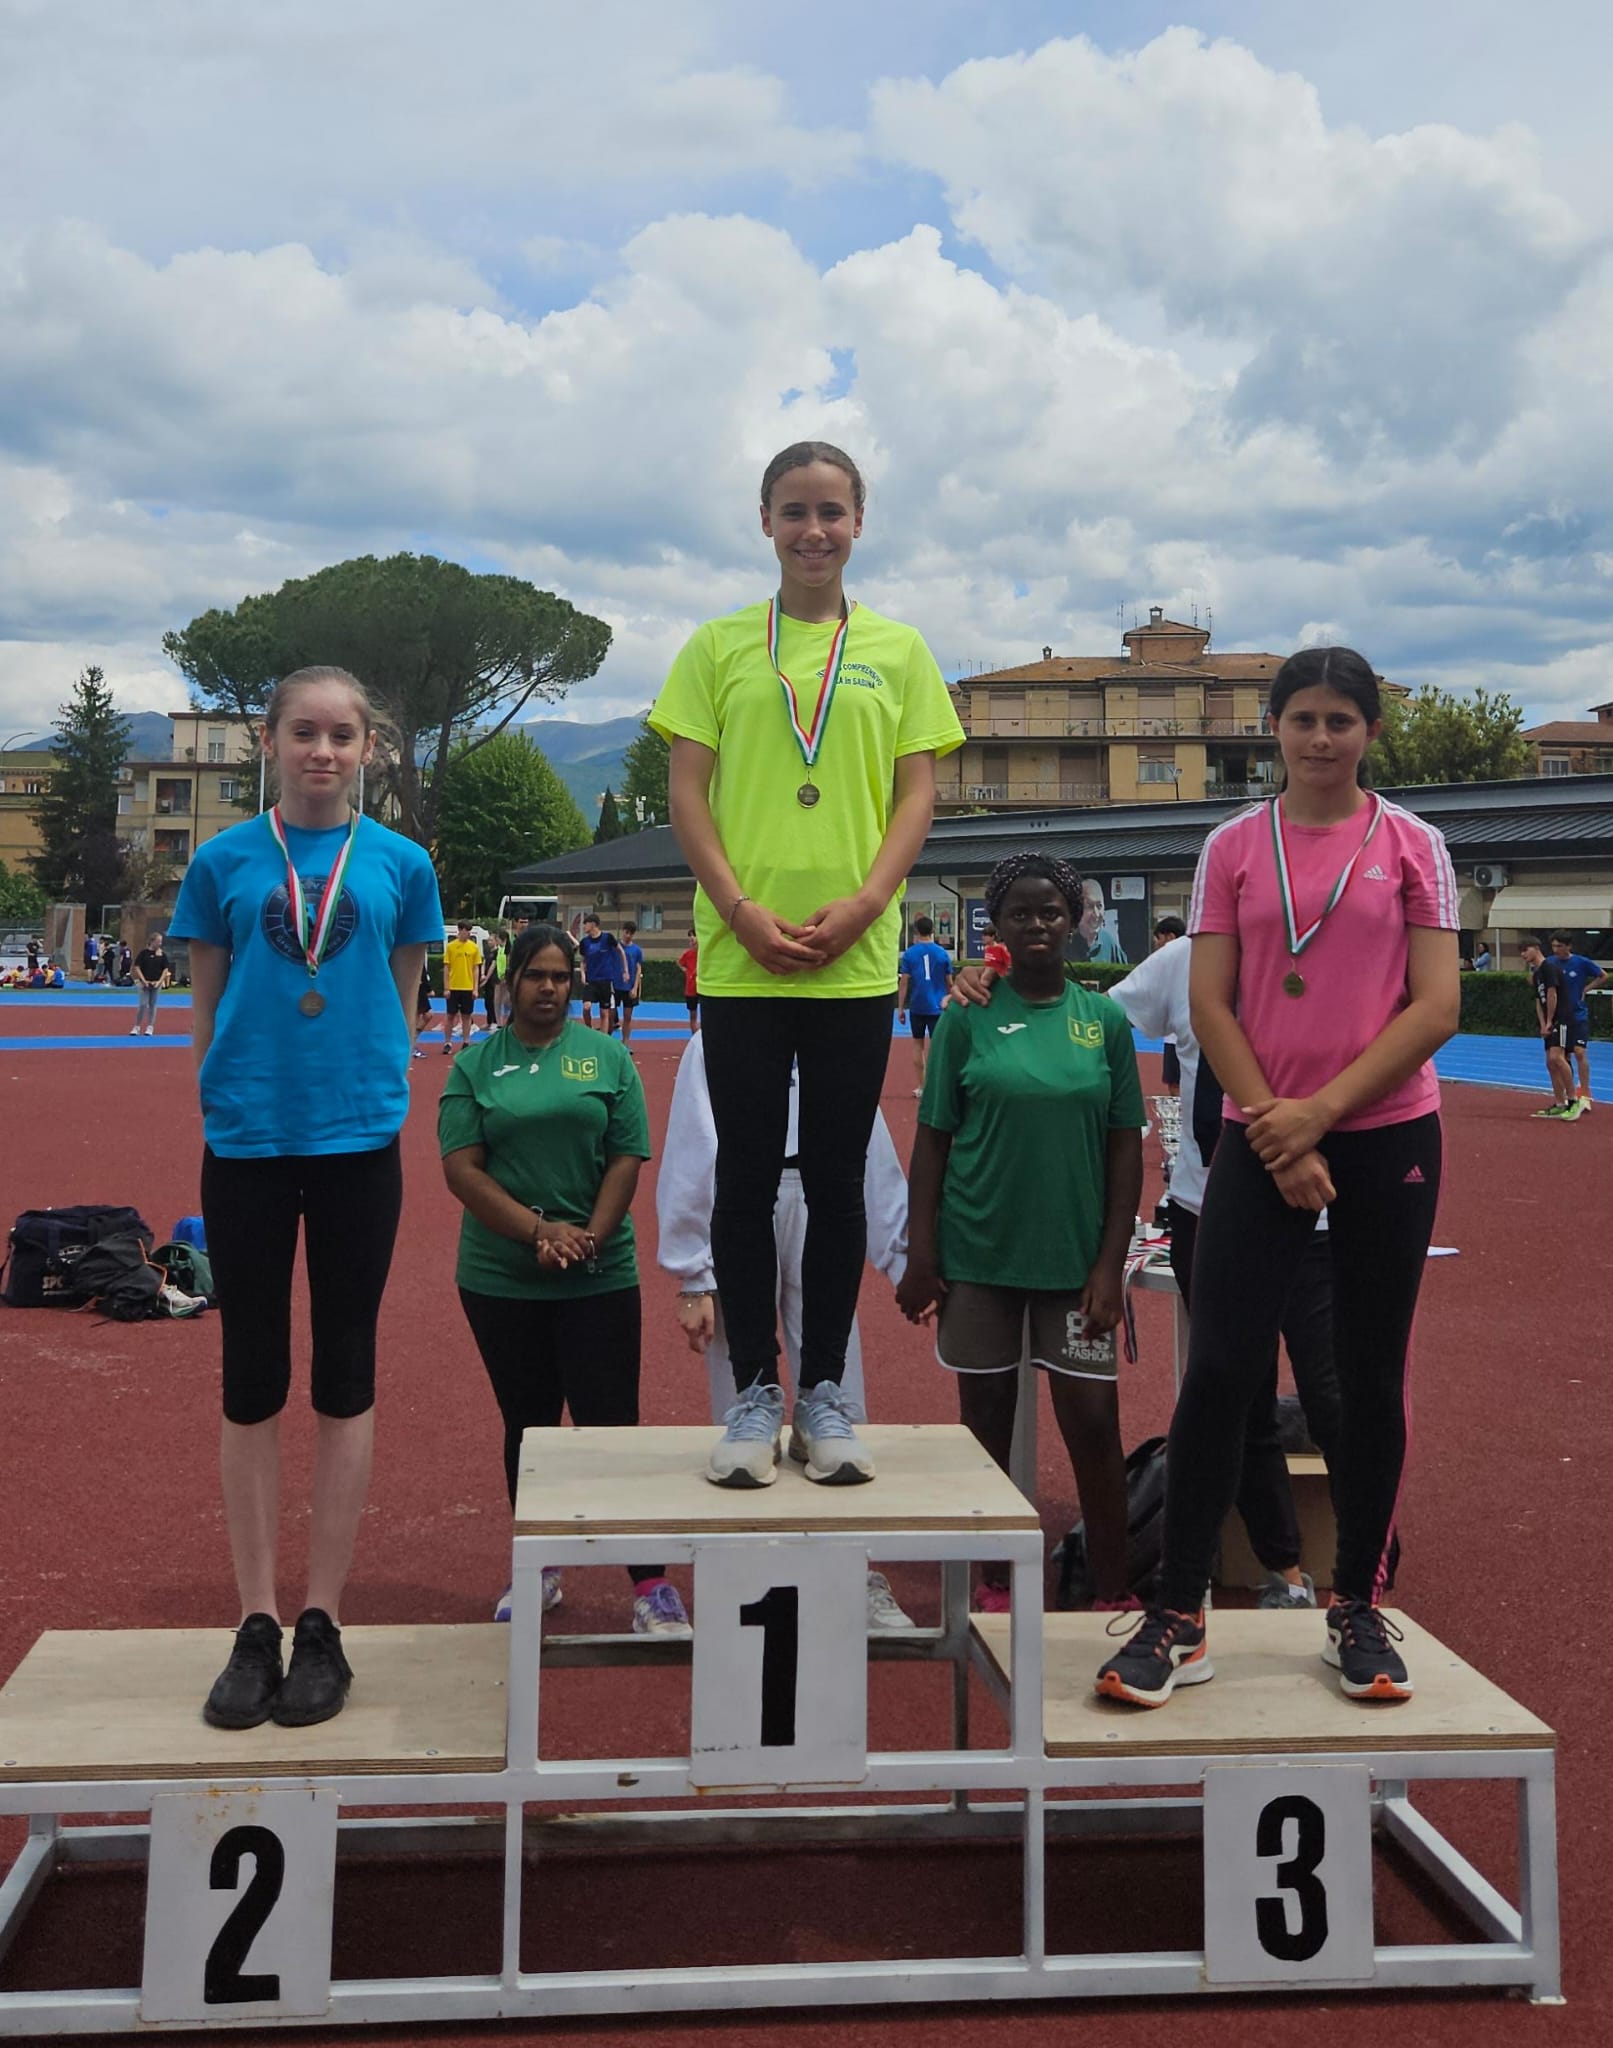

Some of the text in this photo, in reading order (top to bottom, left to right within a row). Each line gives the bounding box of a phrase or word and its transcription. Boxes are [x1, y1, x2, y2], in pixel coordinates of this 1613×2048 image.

[923, 954, 931, 980] 1
[740, 1586, 798, 1746] 1
[204, 1826, 284, 2004] 2
[1256, 1796, 1328, 1961] 3
